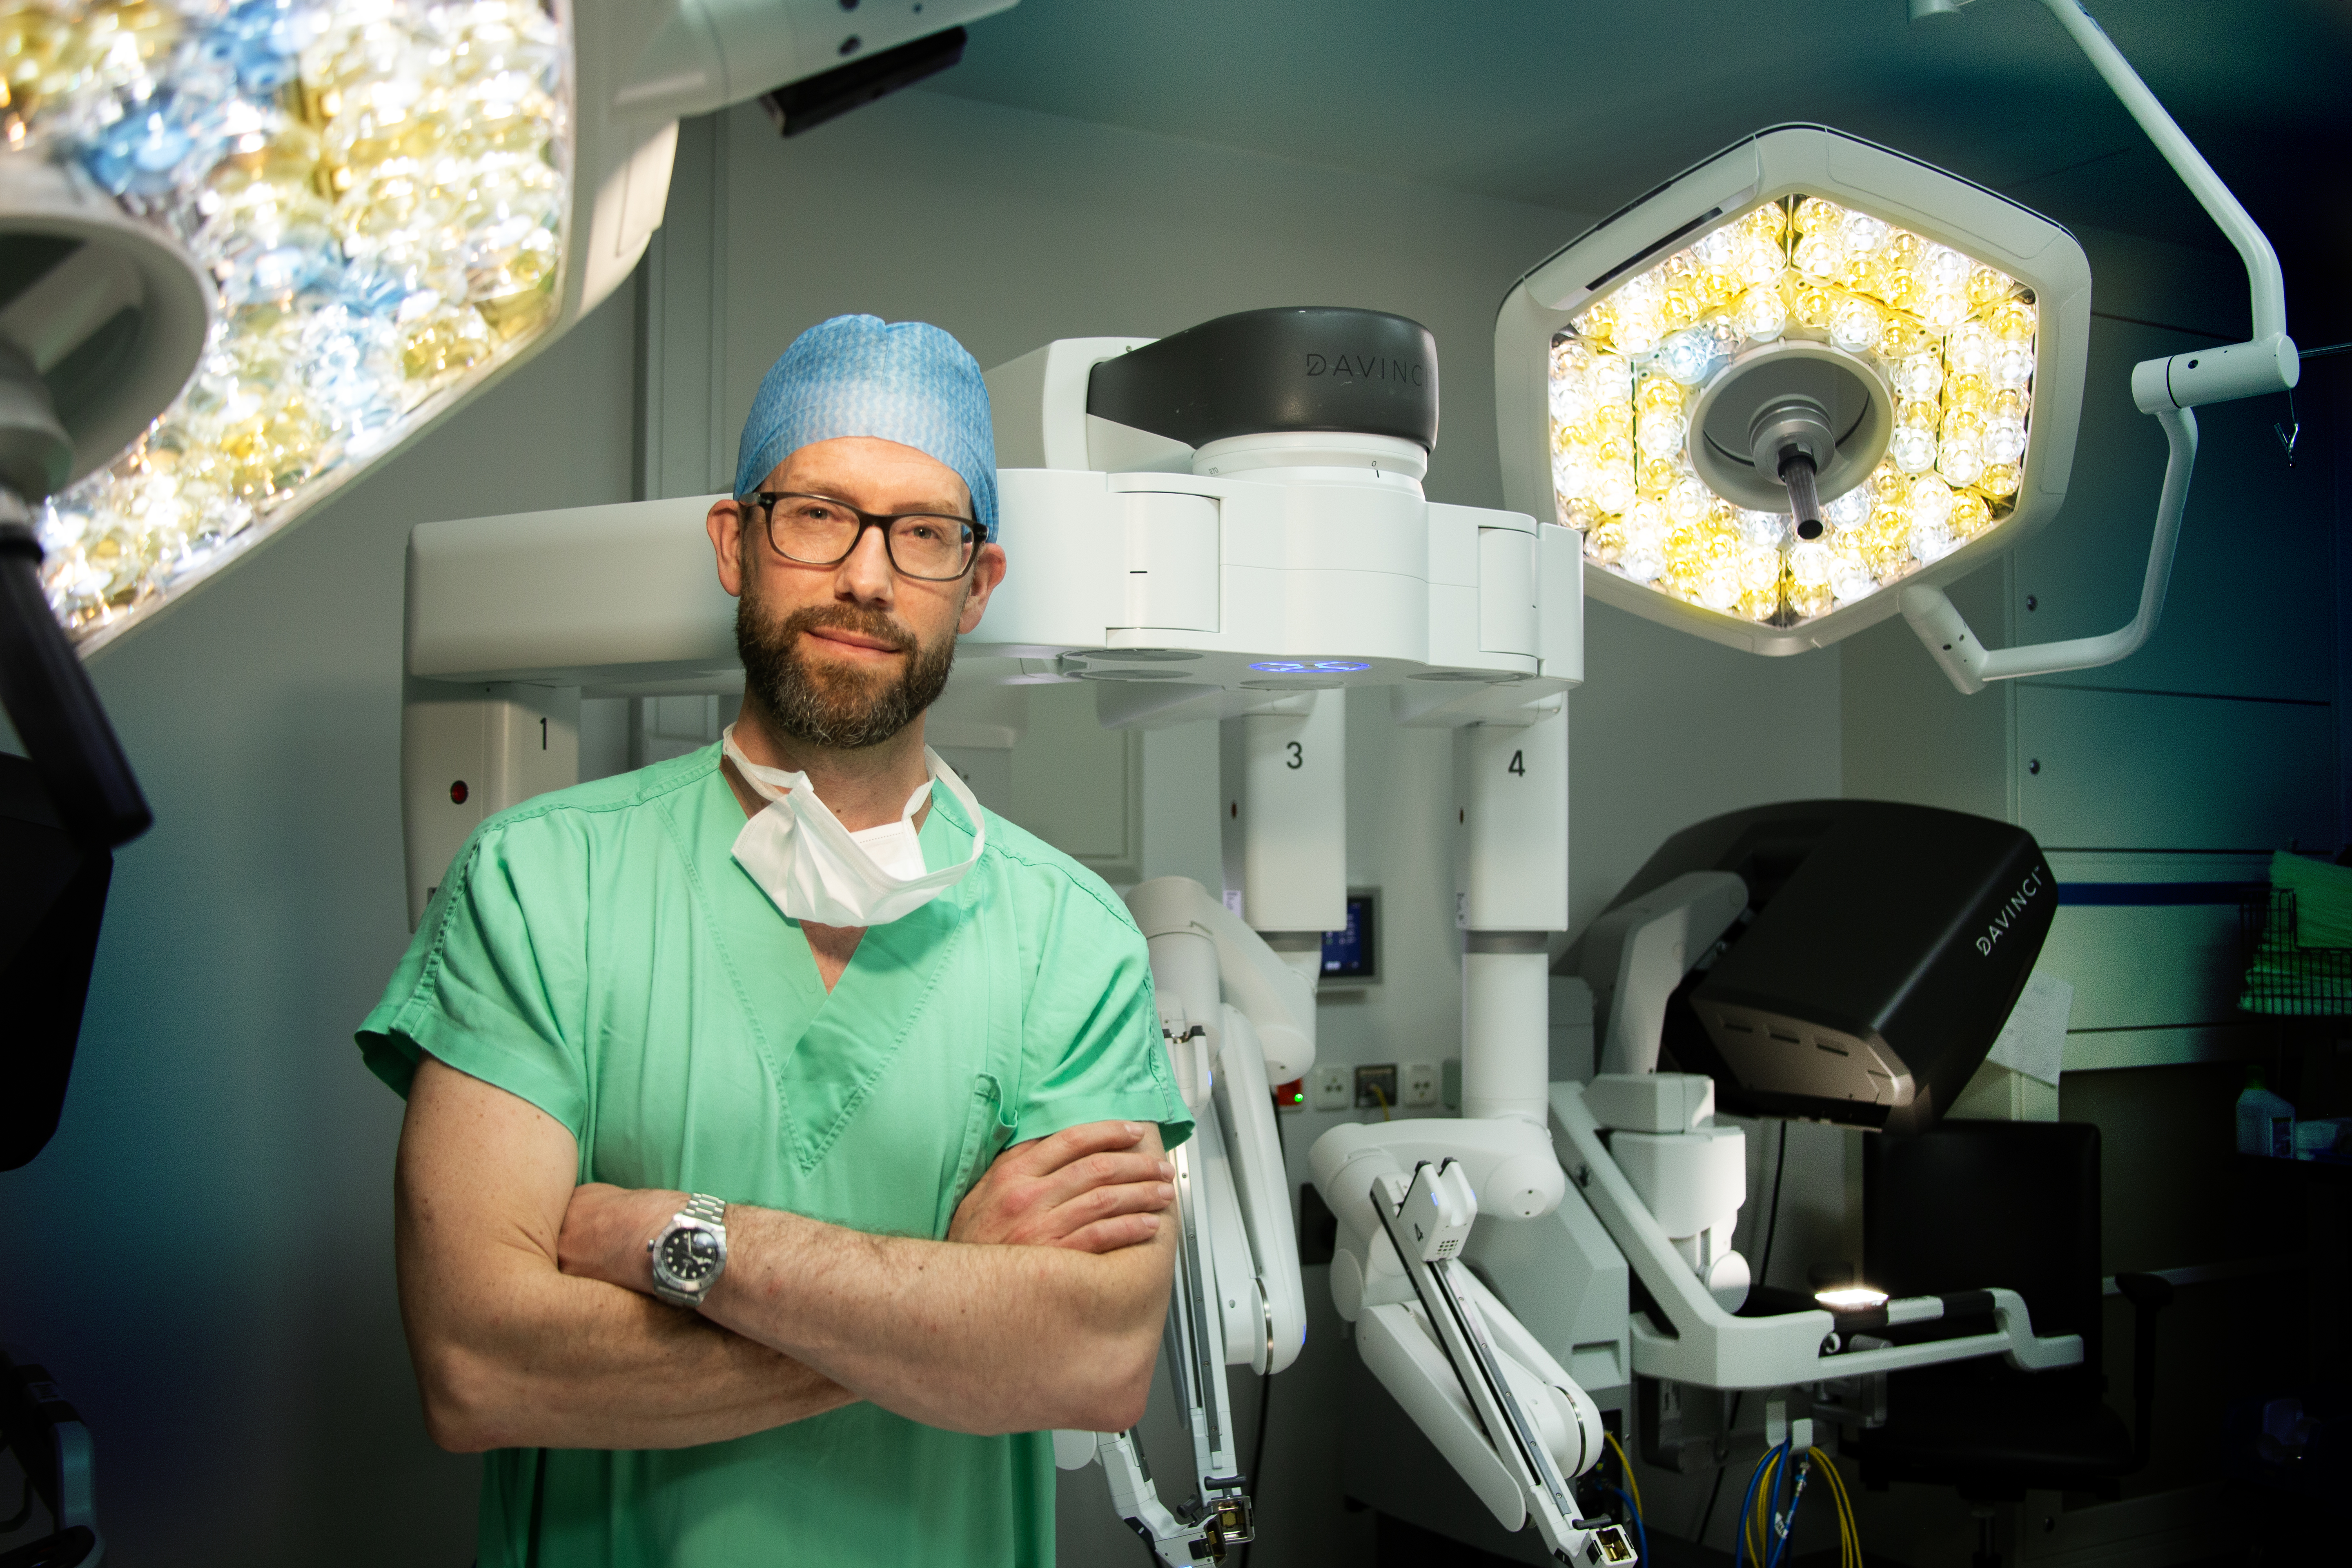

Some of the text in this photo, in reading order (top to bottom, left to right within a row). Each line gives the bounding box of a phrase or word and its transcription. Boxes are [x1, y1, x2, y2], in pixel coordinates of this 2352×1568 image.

[1307, 354, 1428, 389] DAVINCI
[540, 717, 547, 750] 1
[1286, 742, 1303, 769] 3
[1508, 750, 1526, 777] 4
[1976, 871, 2042, 956] DAVINCI
[1414, 1223, 1424, 1242] 4
